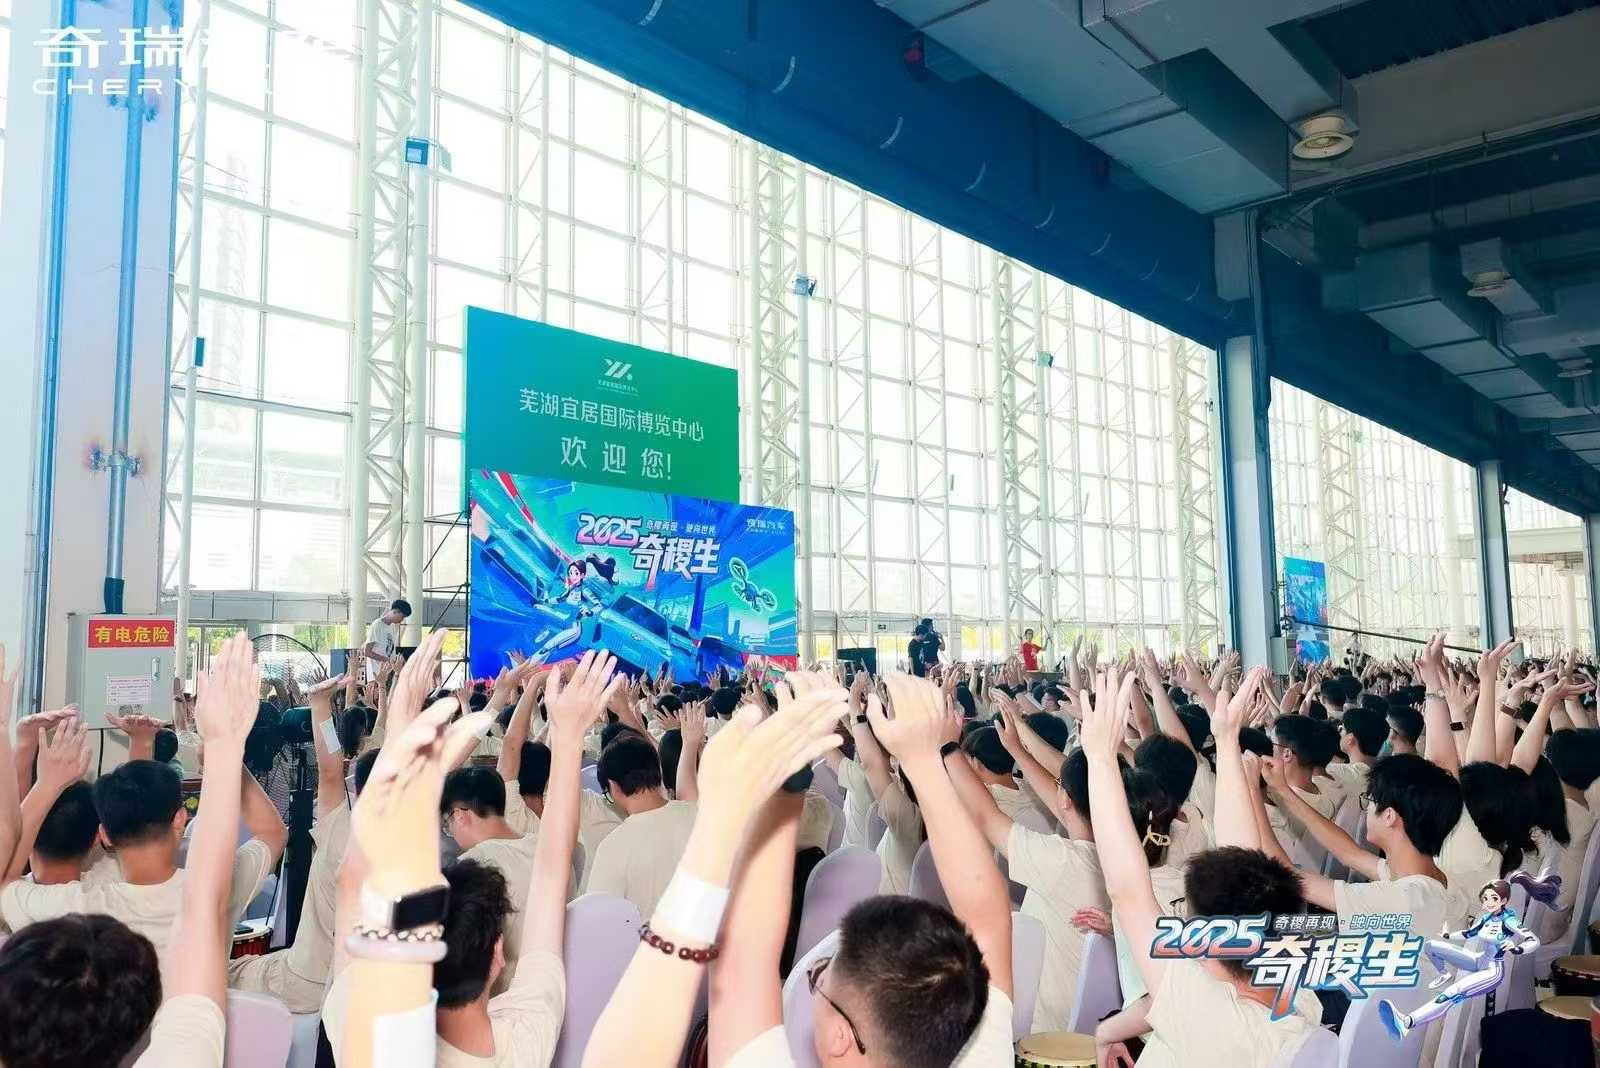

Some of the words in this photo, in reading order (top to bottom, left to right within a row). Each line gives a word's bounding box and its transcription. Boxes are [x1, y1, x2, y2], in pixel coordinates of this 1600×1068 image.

[519, 387, 704, 441] 芜湖宜居国际博览中心
[576, 513, 642, 548] 2025
[630, 533, 721, 591] 奇稷生
[95, 626, 170, 643] 有电危险
